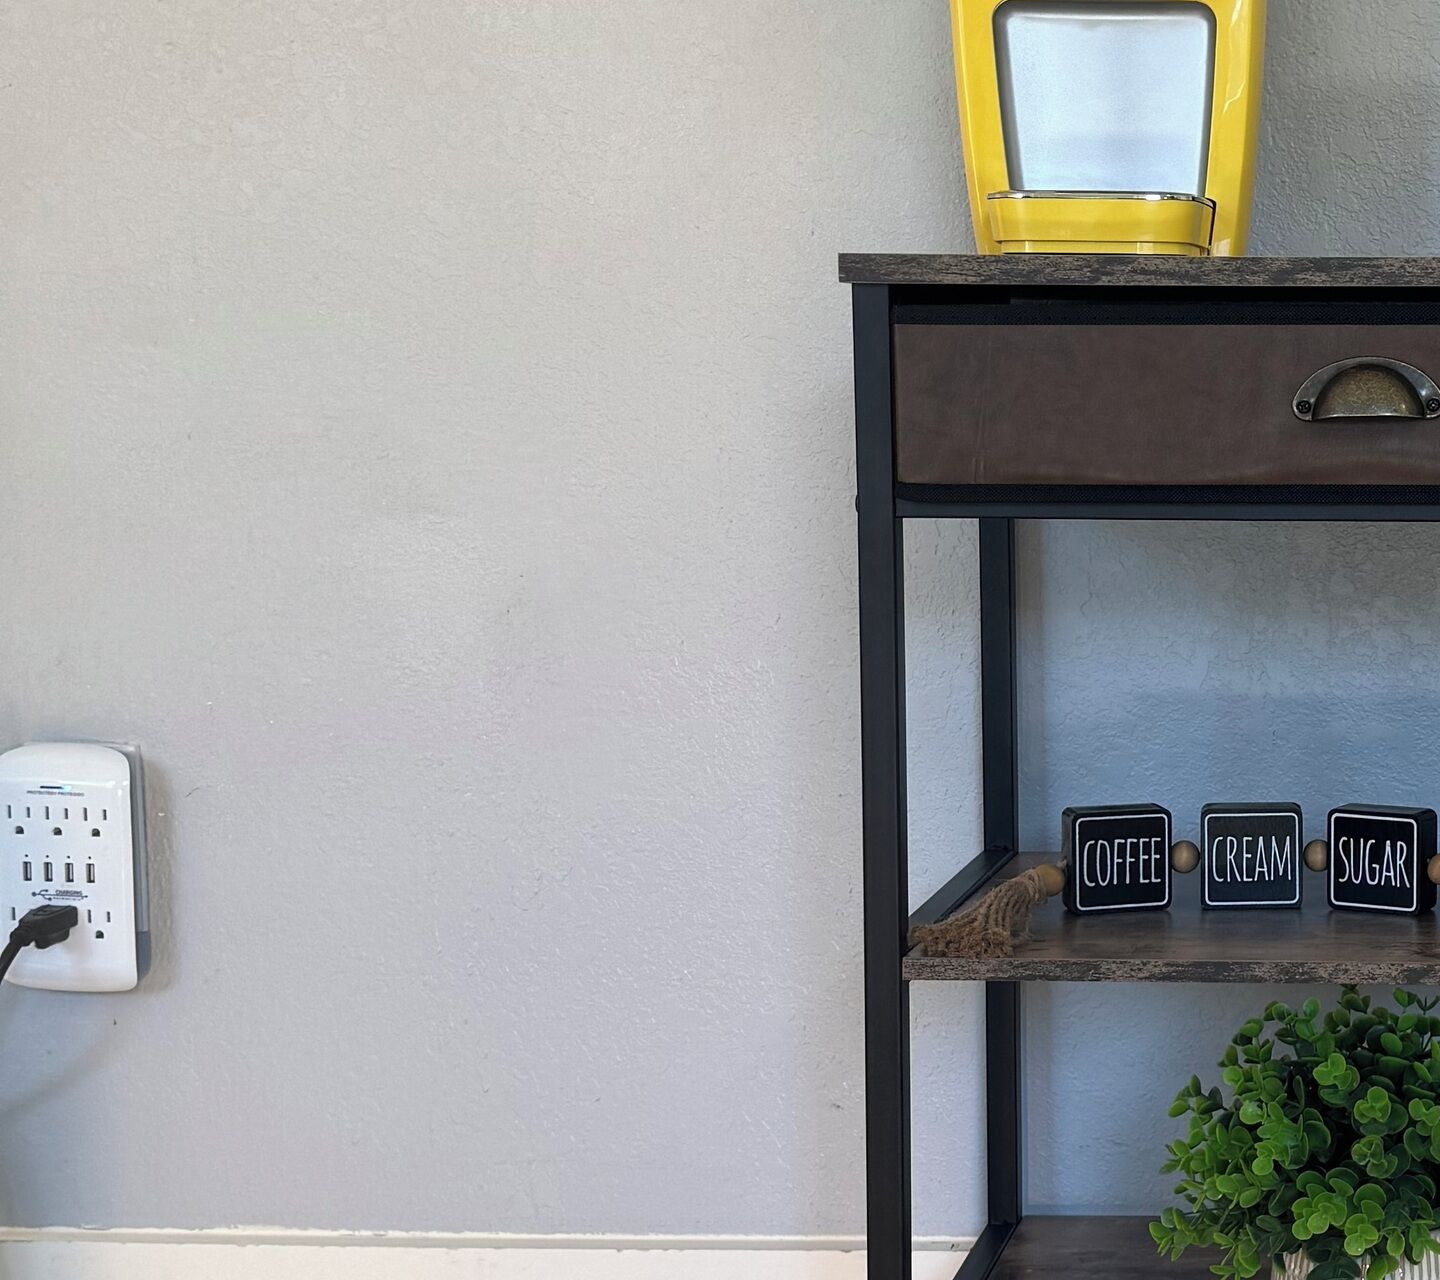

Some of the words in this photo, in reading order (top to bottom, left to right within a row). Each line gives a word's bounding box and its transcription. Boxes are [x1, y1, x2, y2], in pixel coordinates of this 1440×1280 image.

[1083, 837, 1162, 887] COFFEE
[1212, 835, 1292, 883] CREAM
[1338, 836, 1411, 889] SUGAR
